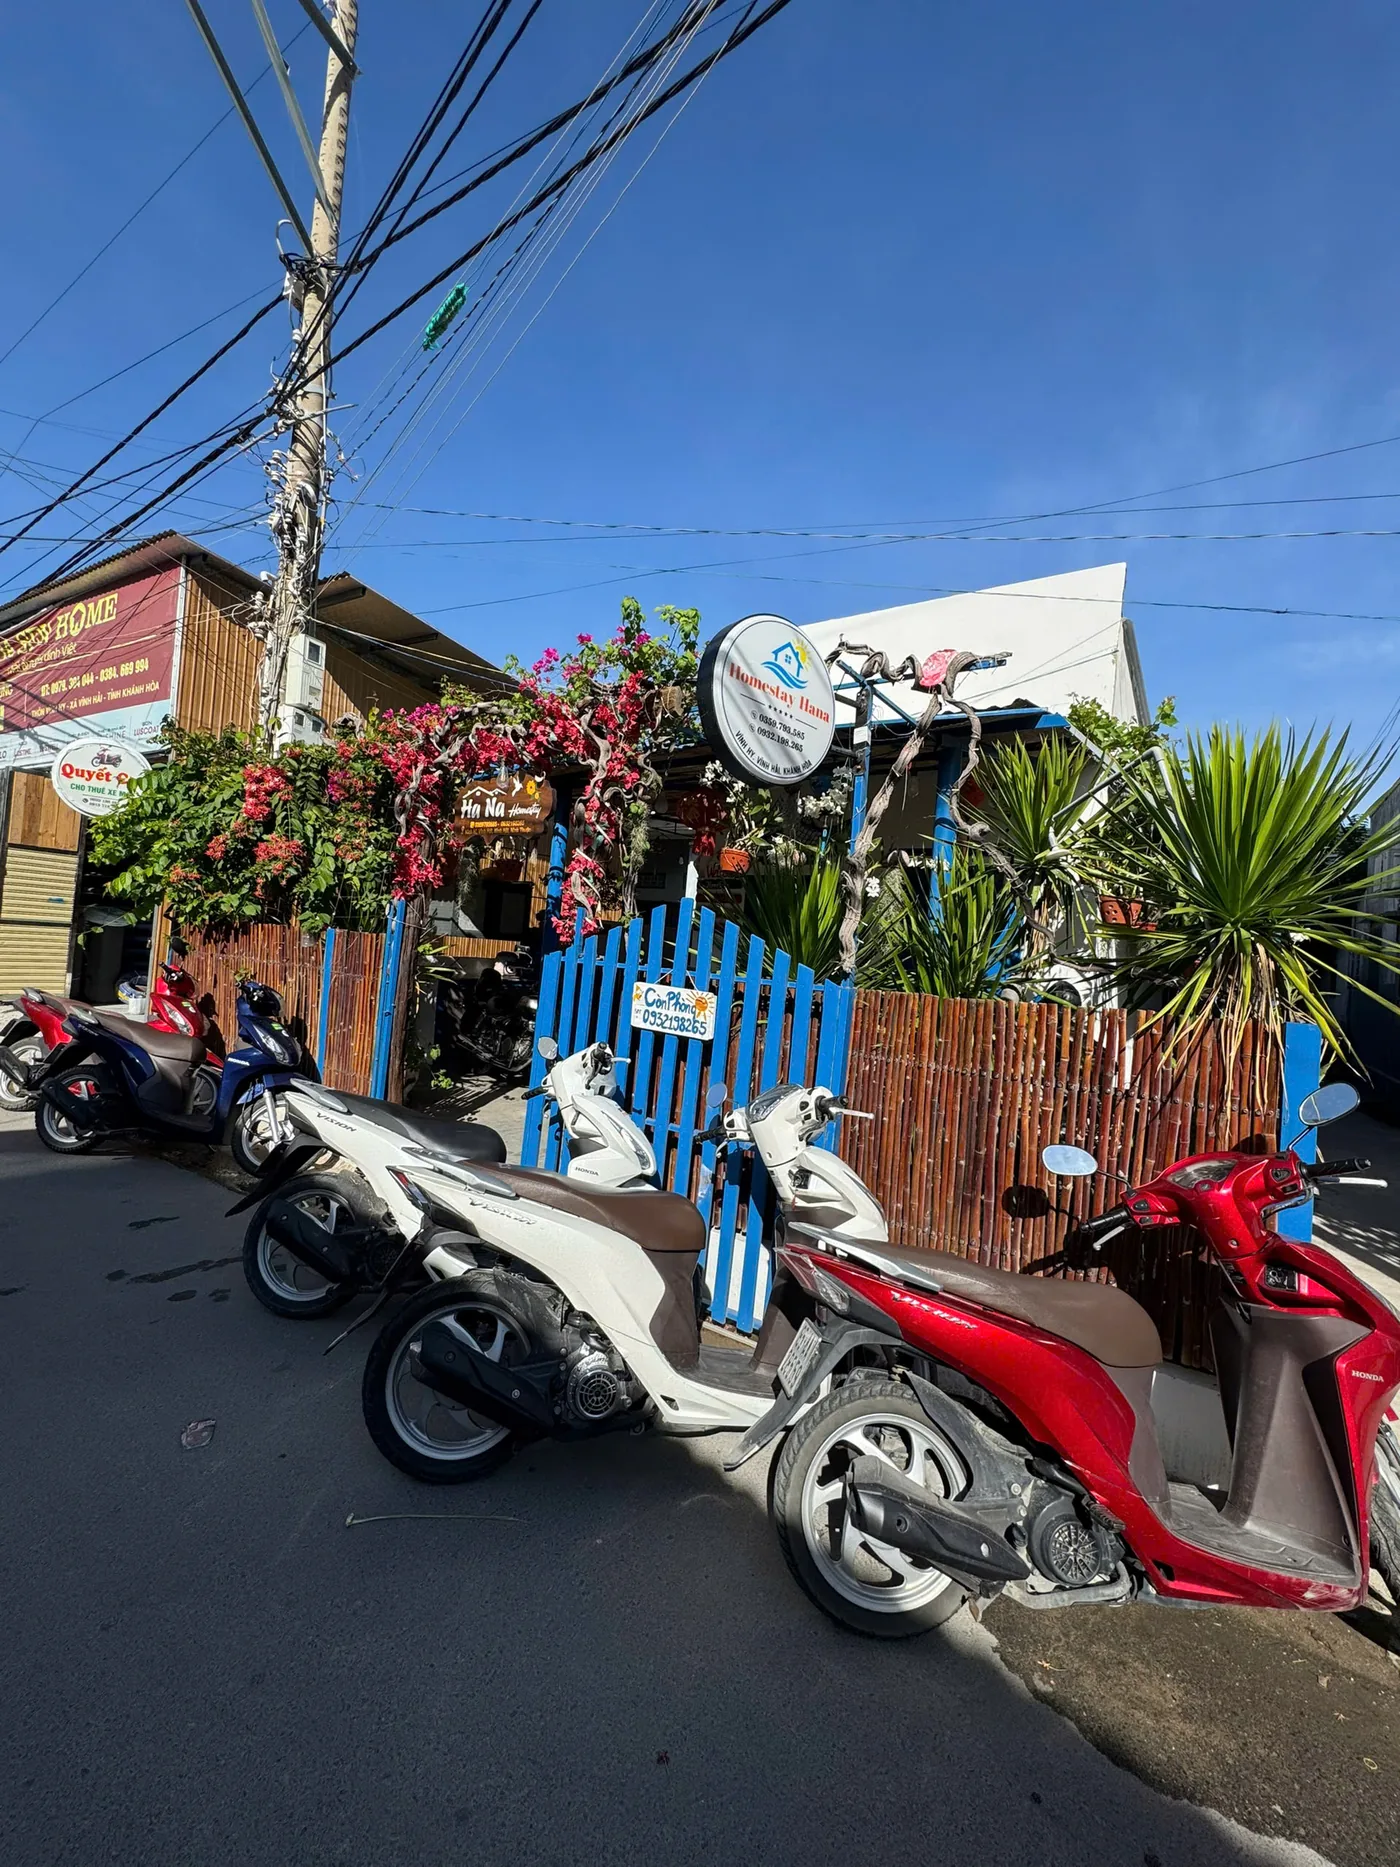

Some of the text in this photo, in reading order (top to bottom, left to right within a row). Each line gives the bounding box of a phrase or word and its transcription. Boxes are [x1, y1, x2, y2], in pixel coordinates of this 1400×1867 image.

[55, 592, 118, 641] HOME
[120, 661, 133, 677] 669
[122, 684, 145, 698] KHÁNH
[145, 679, 160, 692] HÒA
[729, 662, 830, 723] Homestay Hana
[757, 727, 804, 752] 0932.198.265
[61, 763, 112, 782] Quyết
[70, 782, 86, 792] CHO
[87, 785, 105, 795] THUÊ
[461, 798, 481, 819] Ha
[485, 797, 505, 818] Na
[644, 987, 697, 1020] Còn Phòng
[642, 1009, 707, 1036] 0932198265
[316, 1111, 357, 1132] VISION
[575, 1166, 599, 1176] HONDA
[469, 1197, 537, 1225] VISION
[1351, 1369, 1385, 1382] HONDA
